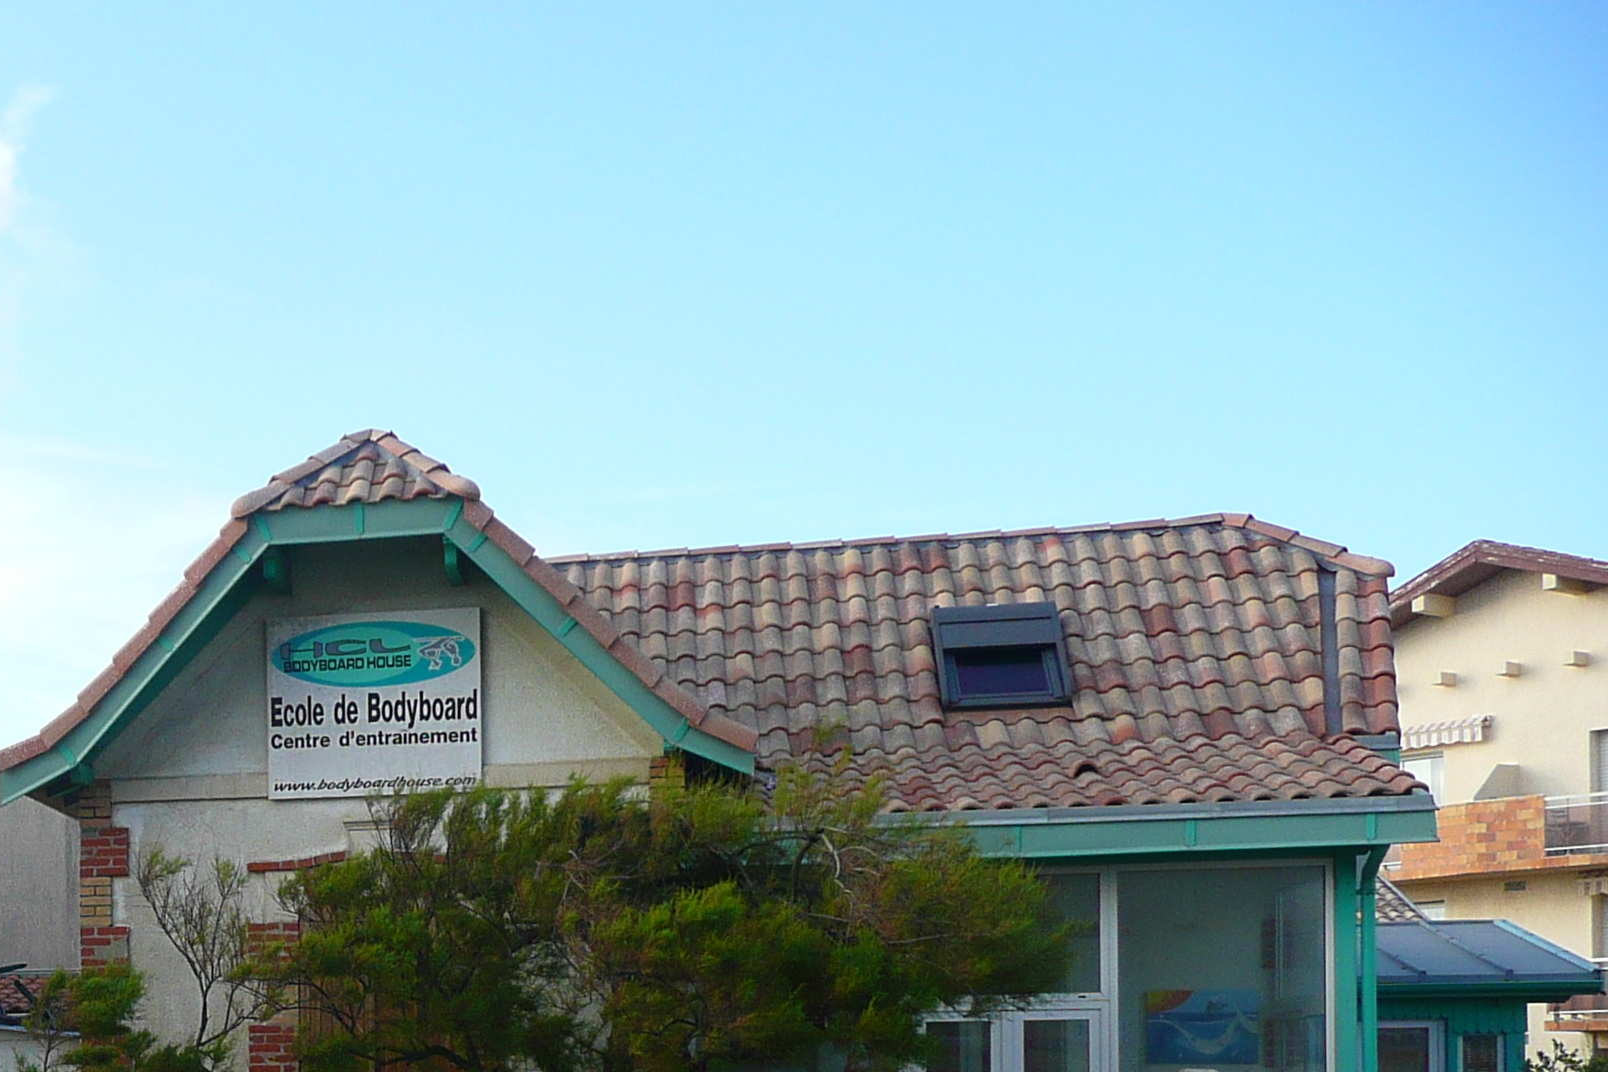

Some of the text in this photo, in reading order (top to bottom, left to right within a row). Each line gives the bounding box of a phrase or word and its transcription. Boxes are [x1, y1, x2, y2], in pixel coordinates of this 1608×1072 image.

[284, 654, 412, 673] BODYBOARD HOUSE
[270, 688, 478, 729] Ecole de Bodyboard
[270, 733, 331, 750] Centre
[274, 774, 477, 792] www.bodyboardhouse.com
